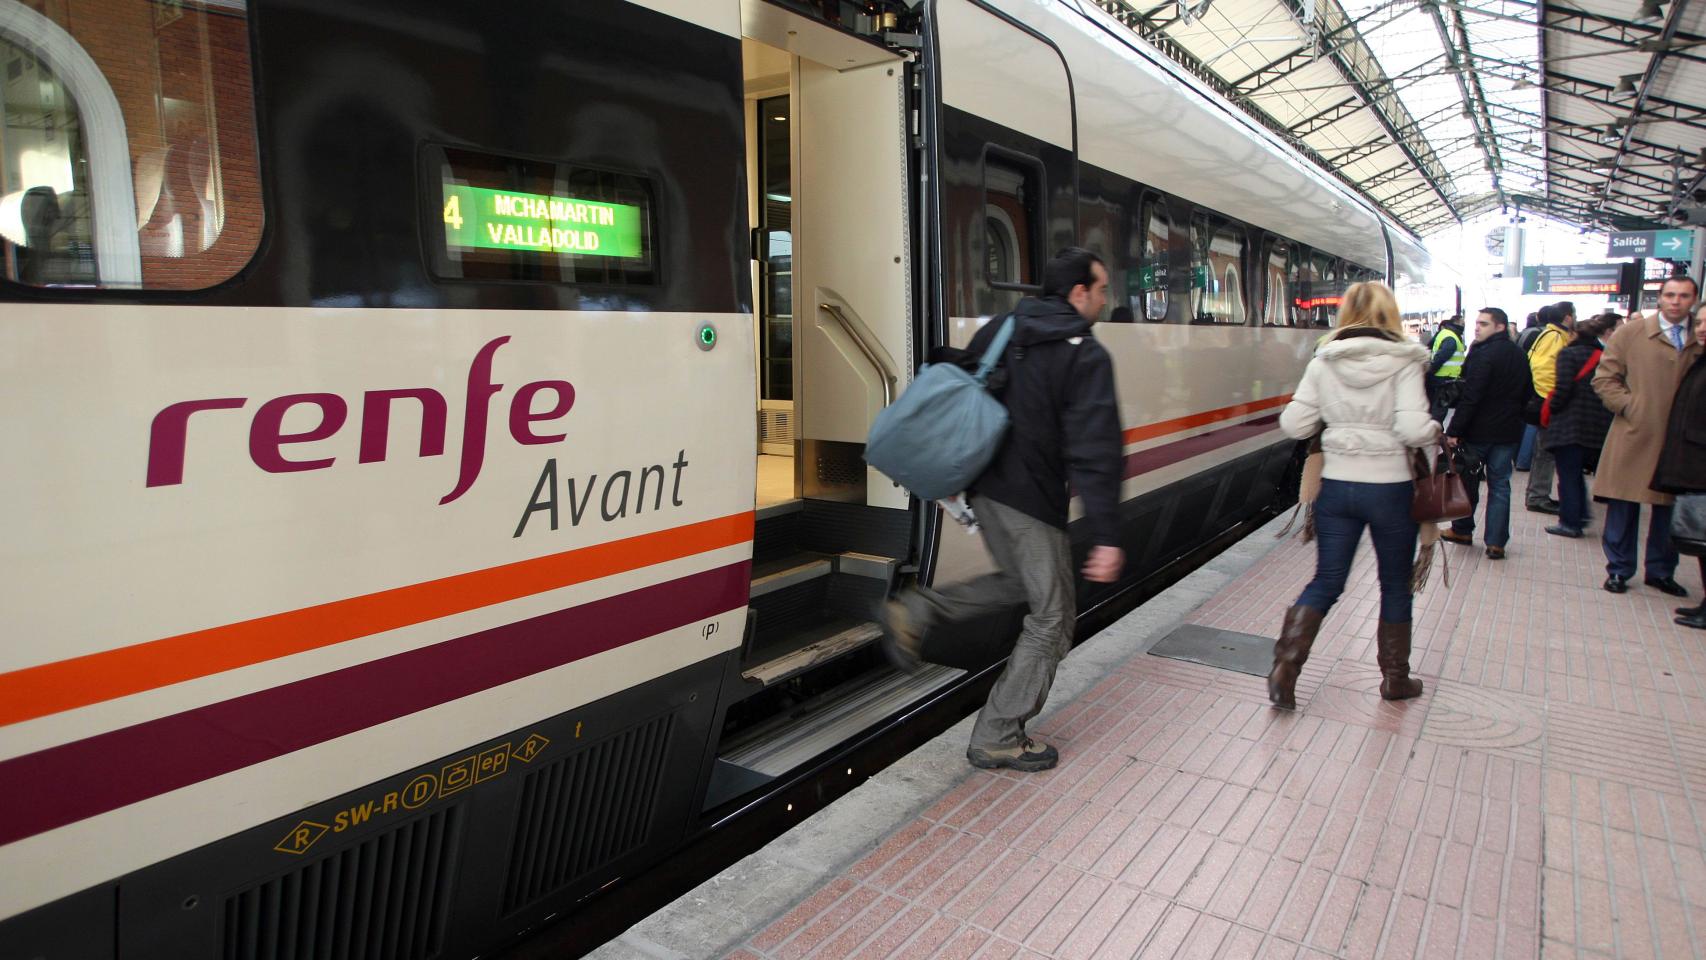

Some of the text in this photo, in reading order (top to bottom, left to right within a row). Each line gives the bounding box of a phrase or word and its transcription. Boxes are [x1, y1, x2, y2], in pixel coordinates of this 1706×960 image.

[443, 195, 464, 230] 4
[493, 194, 614, 226] MCHAMARTIN
[487, 222, 600, 251] VALLADOLID
[1613, 236, 1647, 247] Salida
[1536, 280, 1545, 292] 1
[146, 335, 576, 506] renfe
[512, 449, 689, 538] Avant
[333, 791, 398, 832] SW-R
[481, 752, 505, 772] ep
